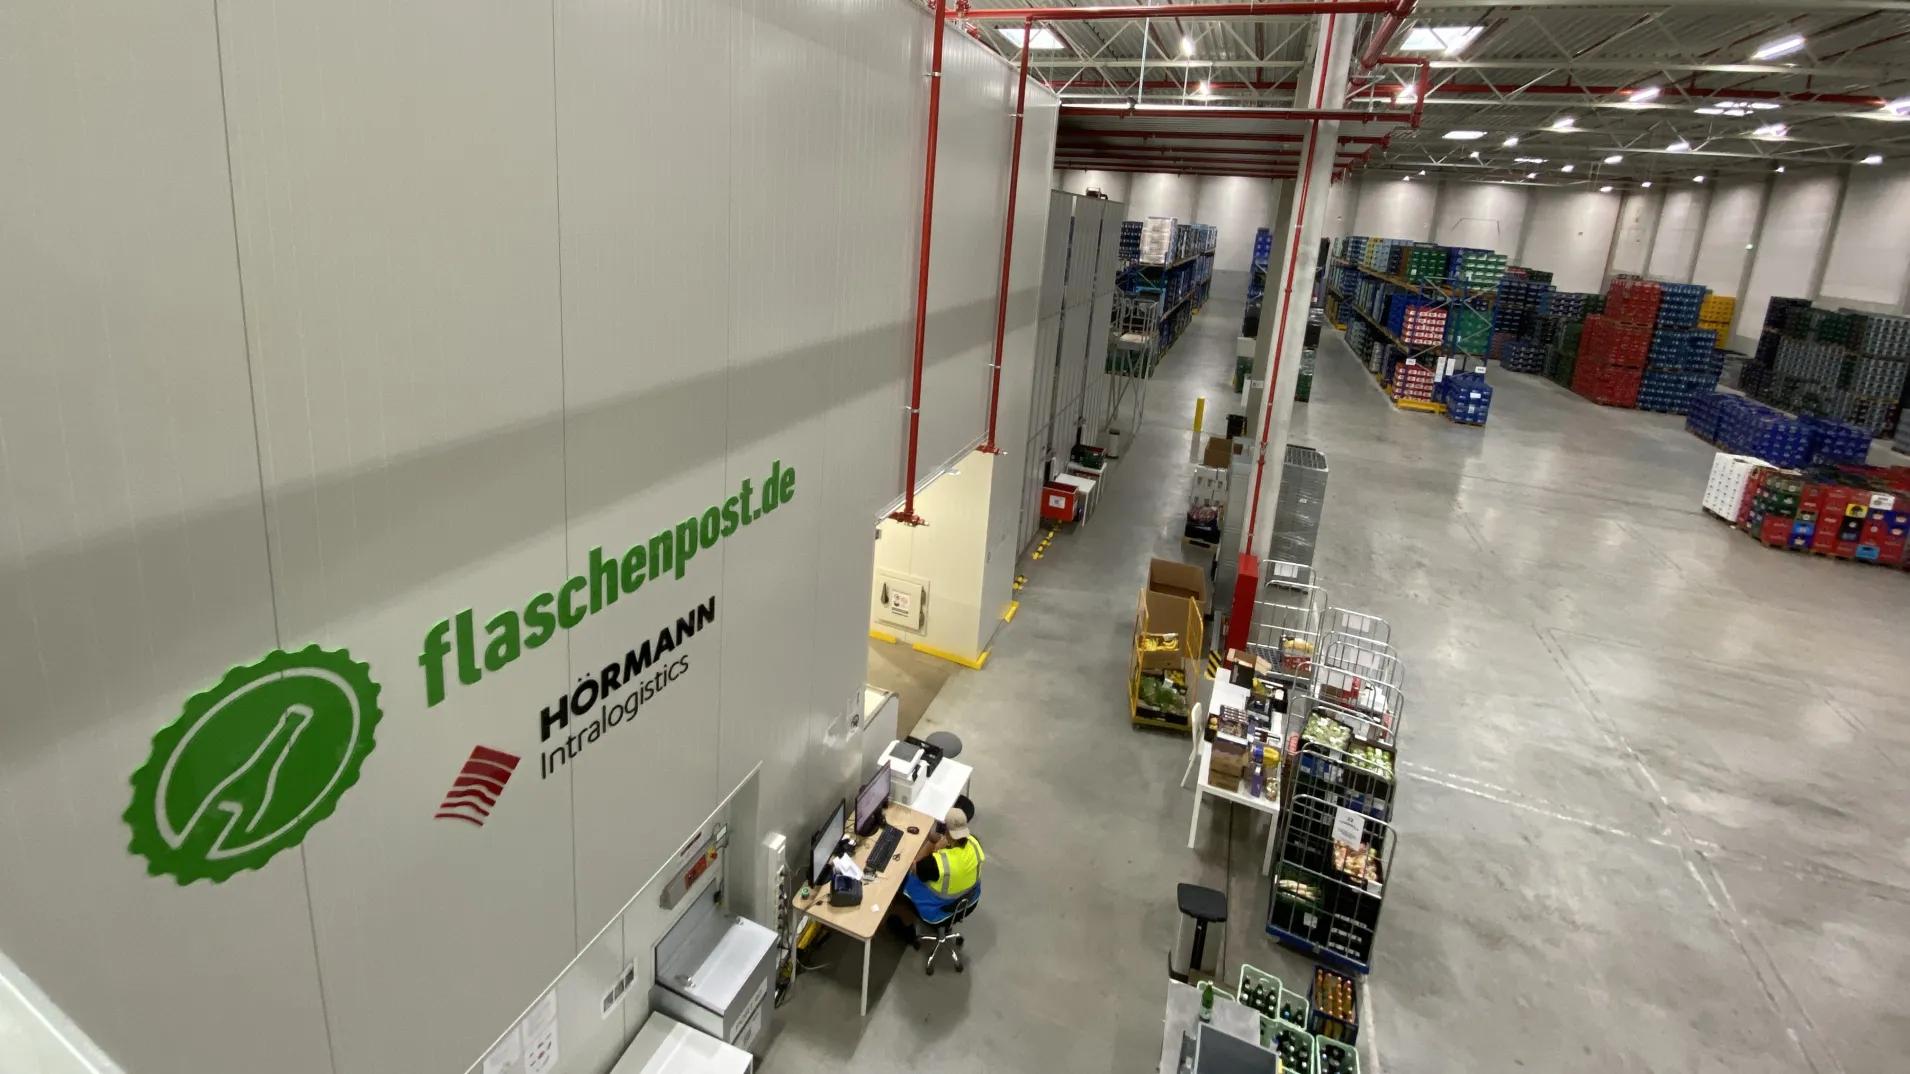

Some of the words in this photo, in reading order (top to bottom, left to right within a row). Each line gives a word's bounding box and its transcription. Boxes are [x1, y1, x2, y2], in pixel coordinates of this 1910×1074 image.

[418, 458, 796, 708] flaschenpost.de
[540, 595, 716, 742] HÖRMANN
[540, 654, 689, 779] Intralogistics
